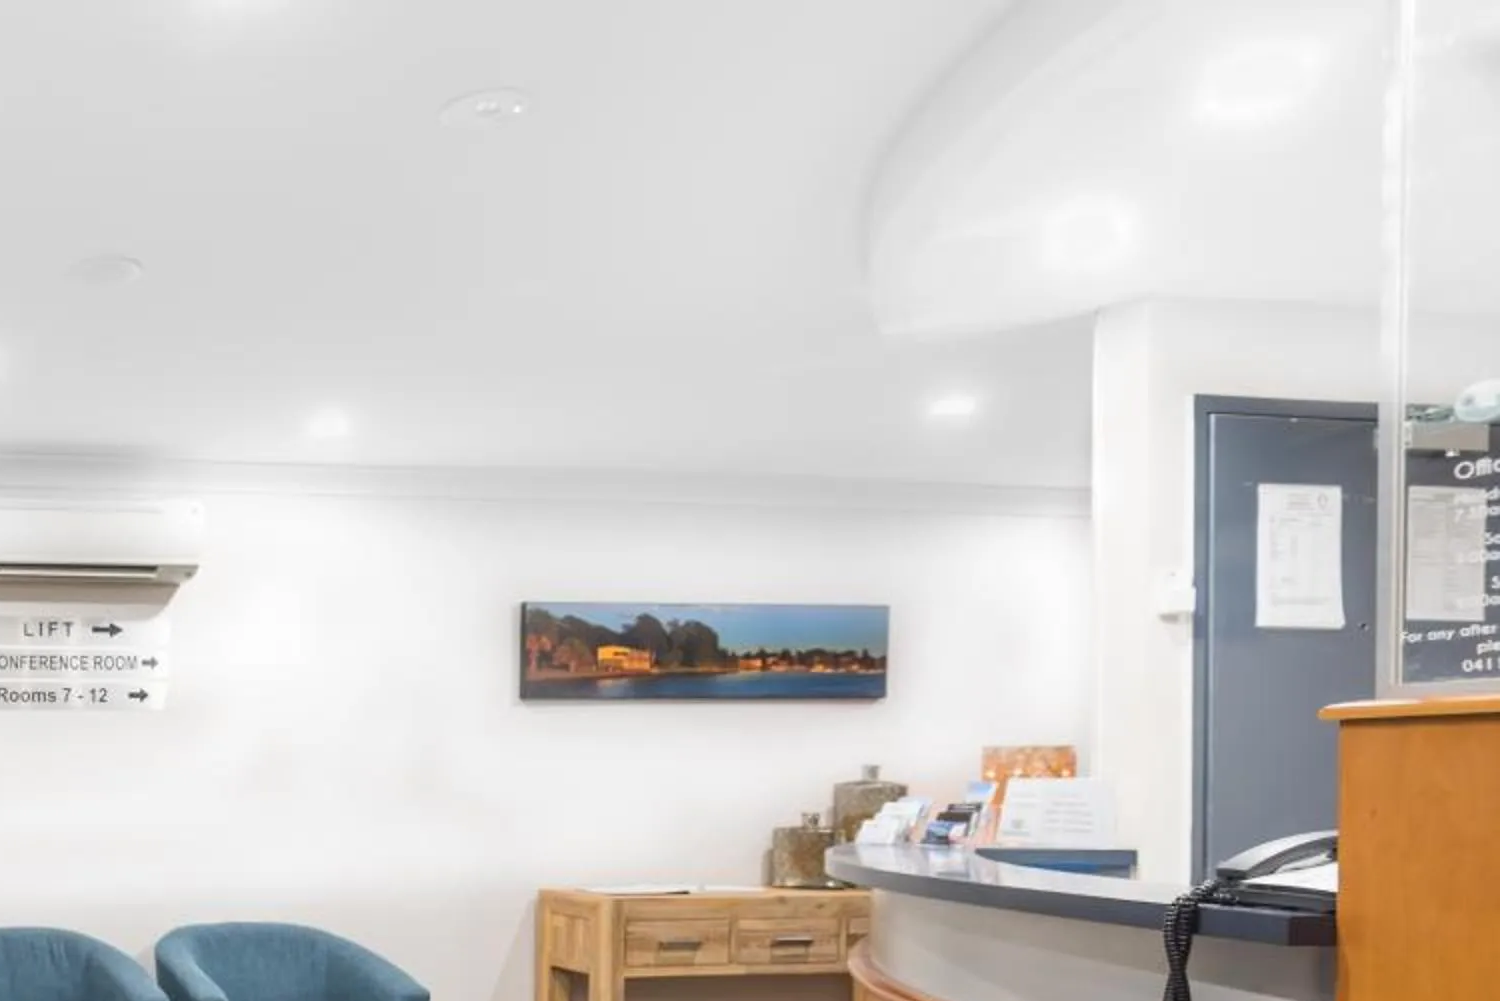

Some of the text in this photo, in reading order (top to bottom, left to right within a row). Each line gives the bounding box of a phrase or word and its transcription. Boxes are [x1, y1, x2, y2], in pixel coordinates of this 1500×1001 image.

[23, 621, 75, 637] LIFT
[1426, 629, 1456, 642] any
[93, 654, 138, 671] ROOM
[63, 687, 72, 703] 7
[89, 687, 109, 703] 12
